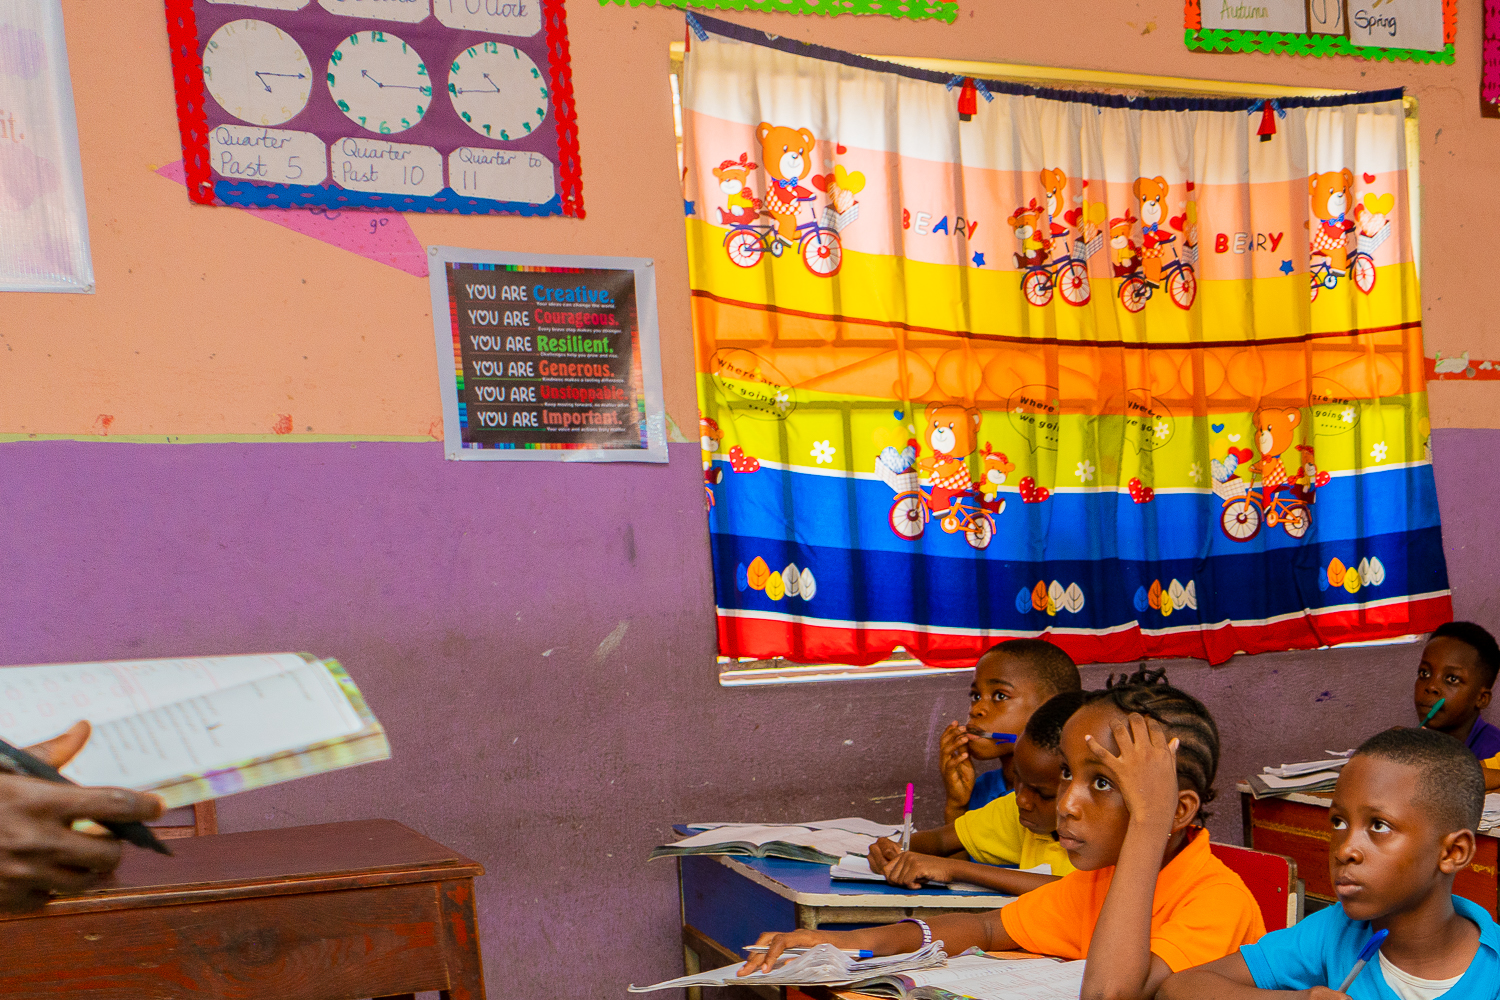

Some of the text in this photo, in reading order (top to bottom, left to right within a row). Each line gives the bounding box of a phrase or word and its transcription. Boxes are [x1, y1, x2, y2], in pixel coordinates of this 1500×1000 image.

[1220, 2, 1269, 20] Autumn
[1354, 9, 1396, 36] Spring
[371, 31, 388, 43] 12
[484, 41, 498, 54] 12
[417, 63, 428, 76] 2
[379, 121, 391, 134] 6
[216, 127, 292, 149] Quarter
[343, 138, 411, 162] Quarter
[459, 148, 541, 168] Quarter to
[221, 152, 302, 179] Past 5
[343, 161, 424, 186] Past 10
[463, 171, 478, 190] 11
[903, 208, 978, 241] BEARY
[466, 284, 615, 304] YOU ARE Creative.
[468, 308, 619, 328] YOU ARE Courageous.
[470, 335, 614, 353] YOU ARE Resilient.
[473, 360, 614, 377] YOU ARE Generous.
[718, 358, 781, 390] Where are
[475, 385, 628, 403] YOU ARE Unstoppable.
[741, 388, 776, 406] going
[1020, 396, 1055, 413] Where
[478, 410, 622, 427] YOU ARE Important.
[1020, 414, 1035, 424] we
[1316, 410, 1342, 420] going
